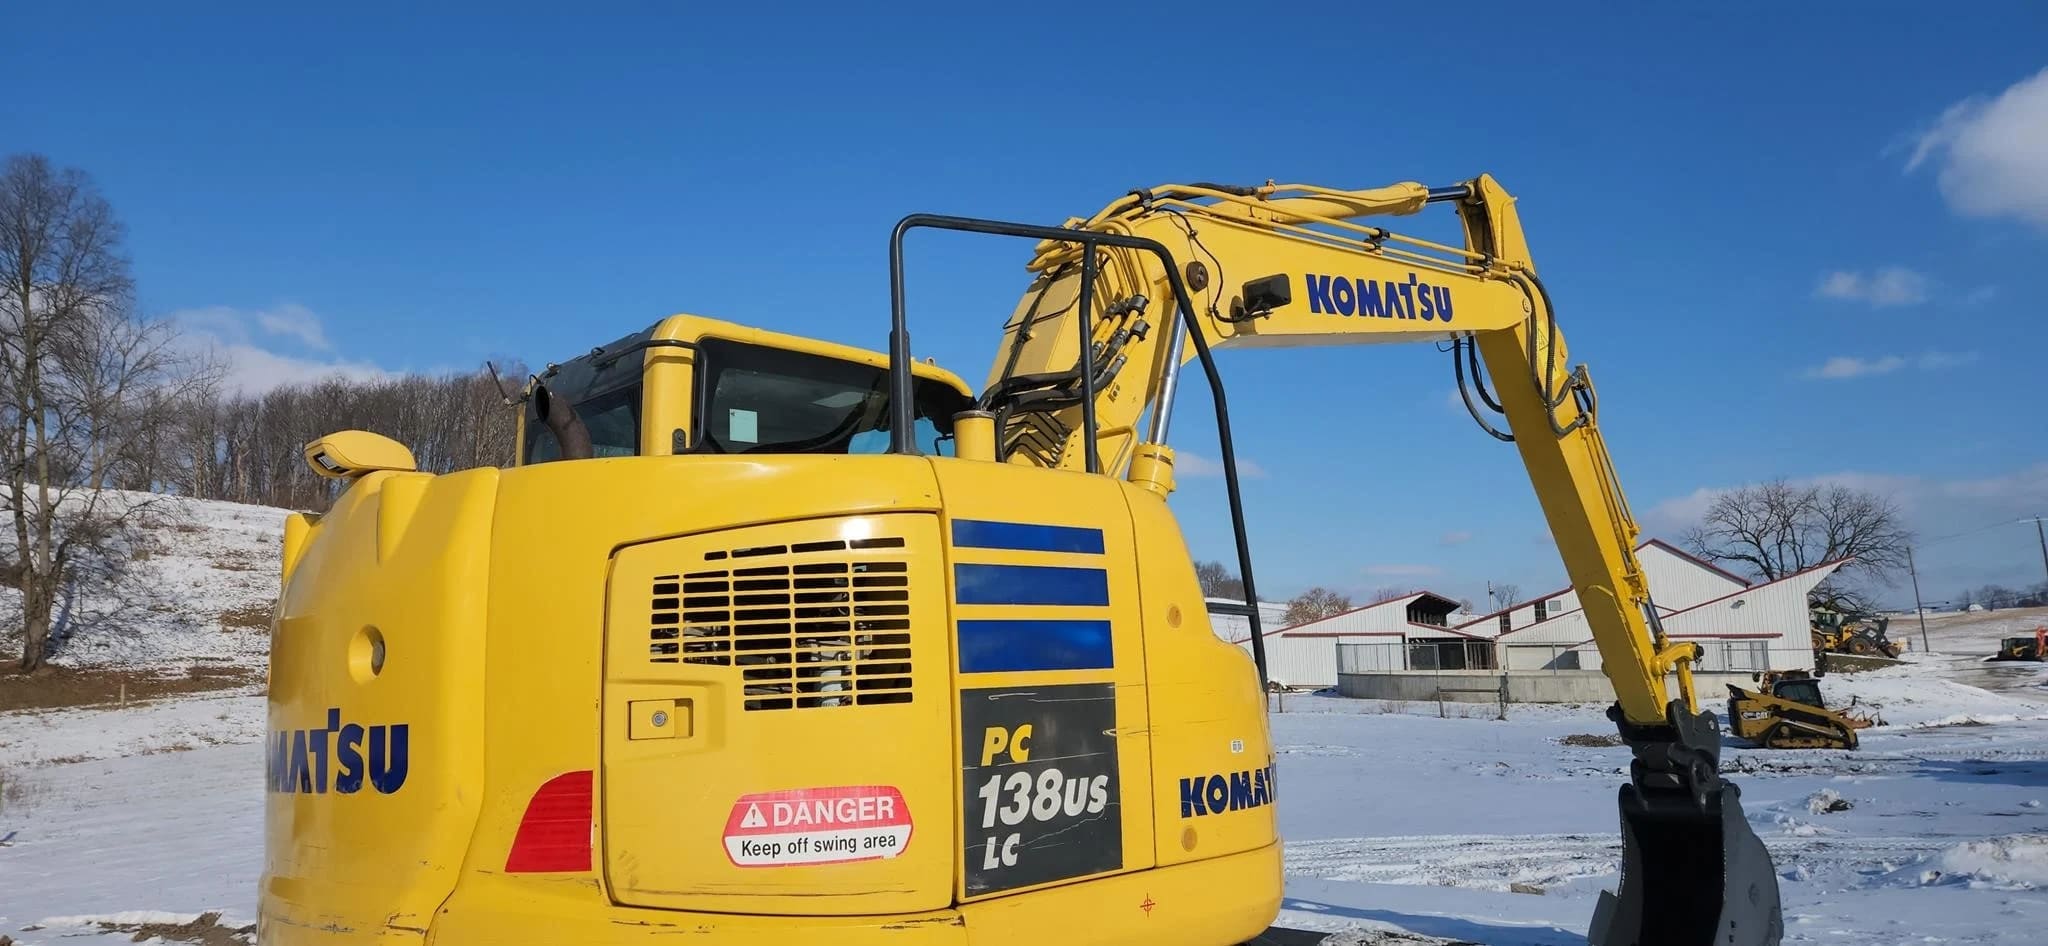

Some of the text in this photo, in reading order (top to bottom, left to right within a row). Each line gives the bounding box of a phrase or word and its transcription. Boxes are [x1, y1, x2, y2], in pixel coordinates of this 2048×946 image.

[1305, 272, 1454, 323] KOMATSU
[269, 708, 409, 794] MATSU
[981, 724, 1033, 767] PC
[978, 768, 1109, 828] 138US
[1179, 754, 1278, 819] KOMAT
[773, 796, 895, 827] DANGER
[742, 834, 896, 859] Keep off swing area
[983, 833, 1021, 870] LC
